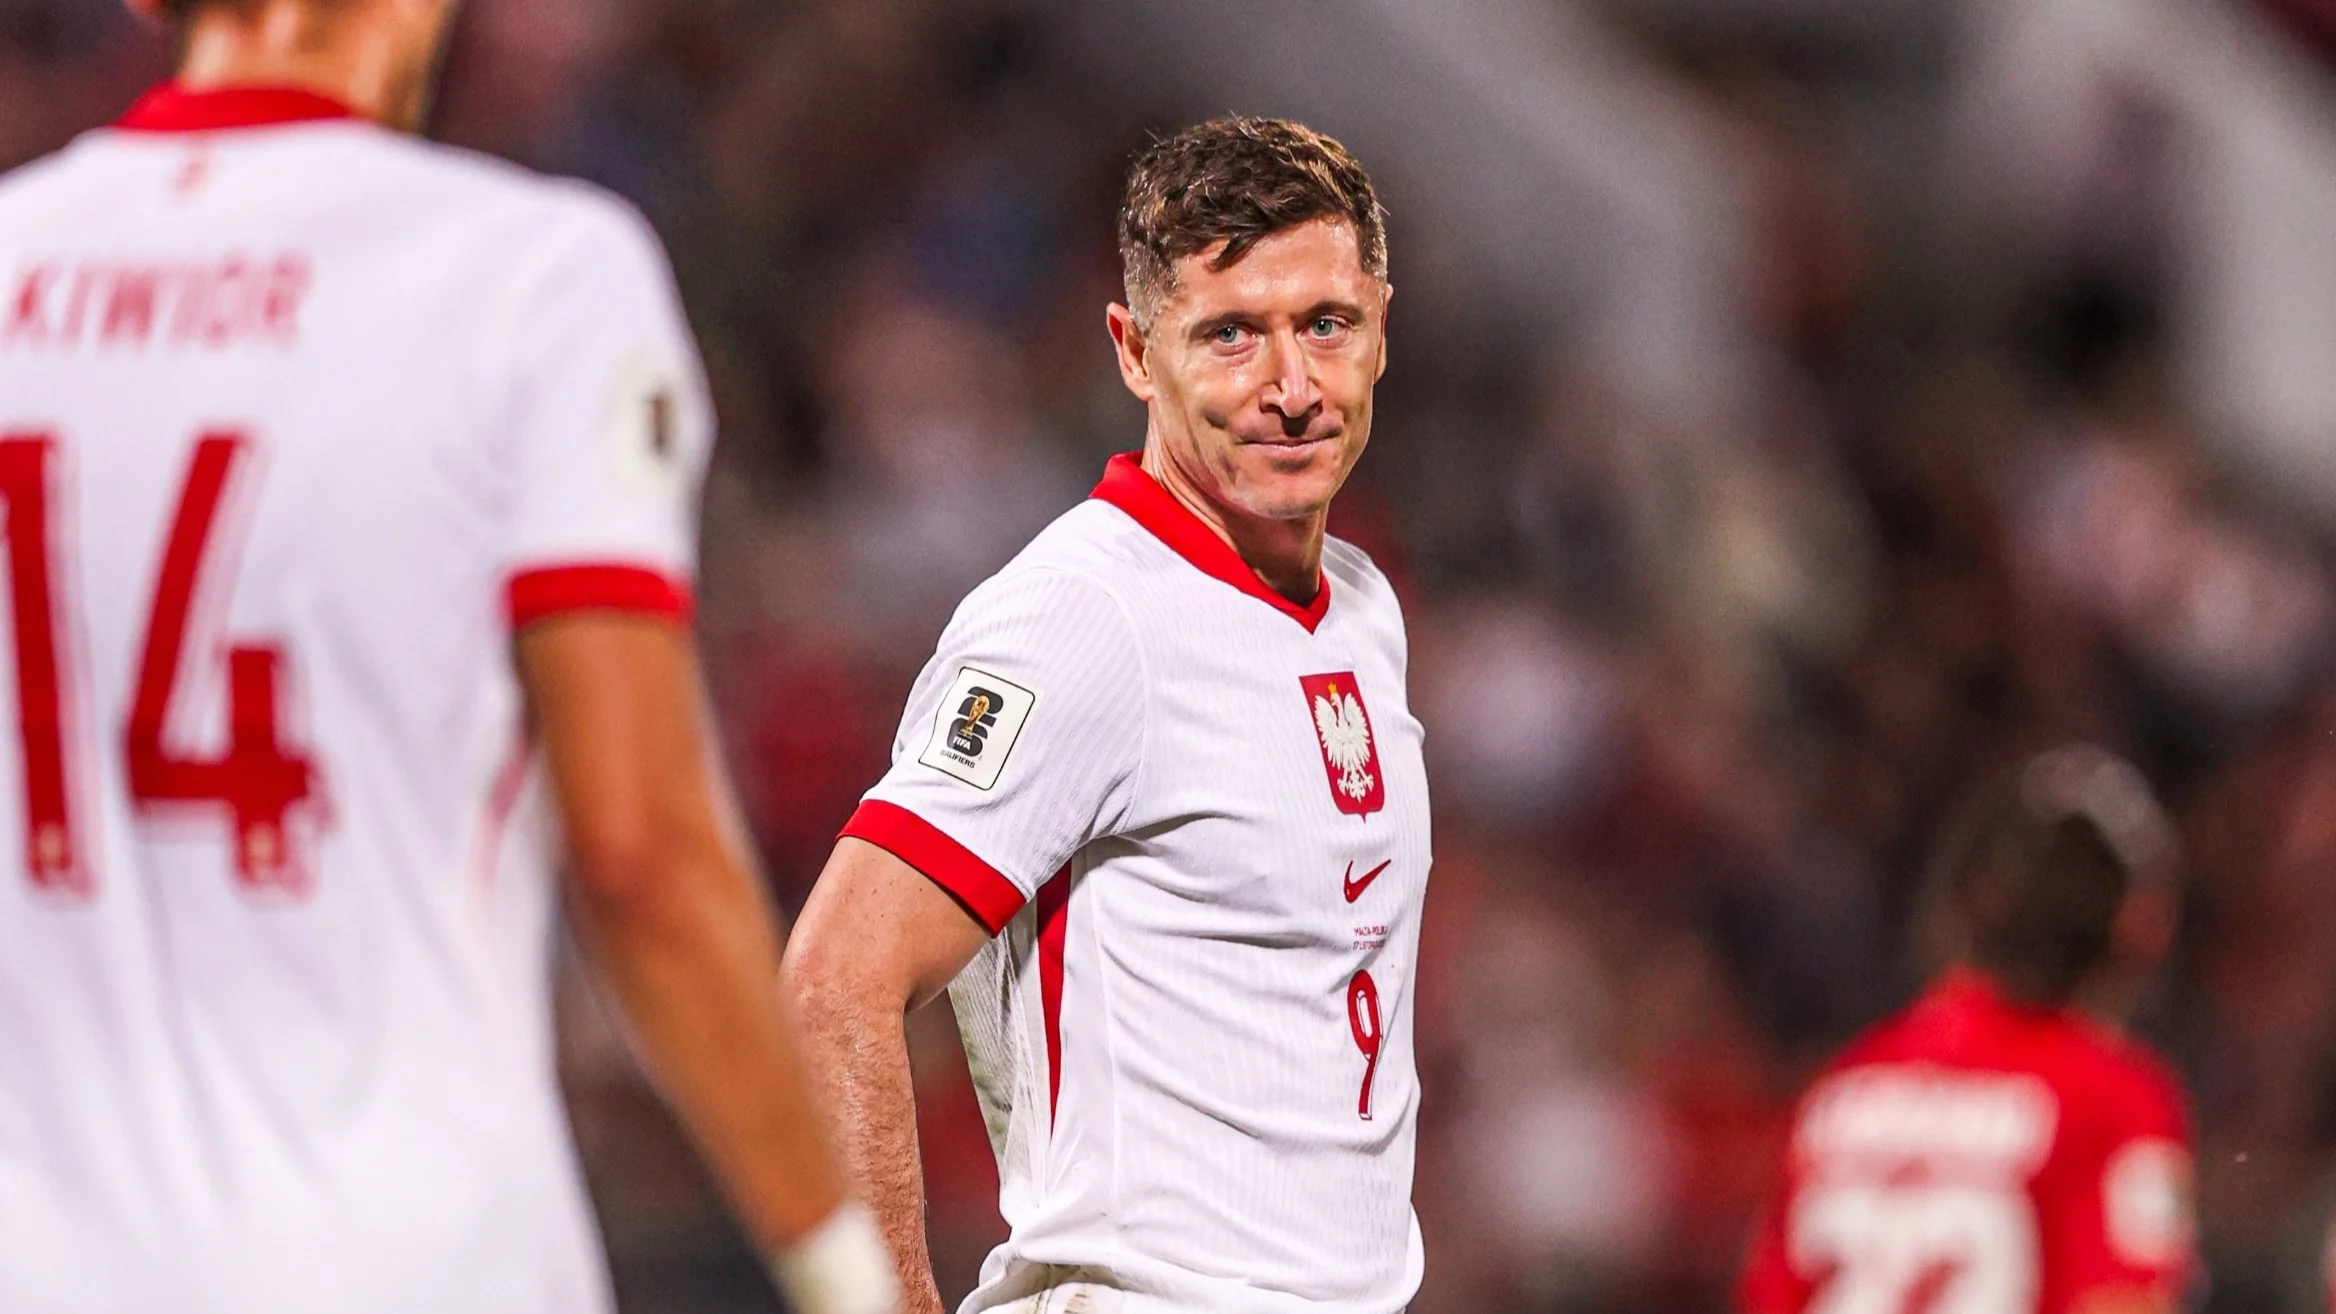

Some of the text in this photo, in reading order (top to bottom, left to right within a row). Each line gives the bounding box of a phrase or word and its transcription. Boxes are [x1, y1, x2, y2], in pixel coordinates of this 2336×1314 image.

[3, 250, 312, 354] KIWIOR
[0, 427, 328, 900] 14
[952, 736, 971, 750] FIFA
[1347, 969, 1383, 1121] 9
